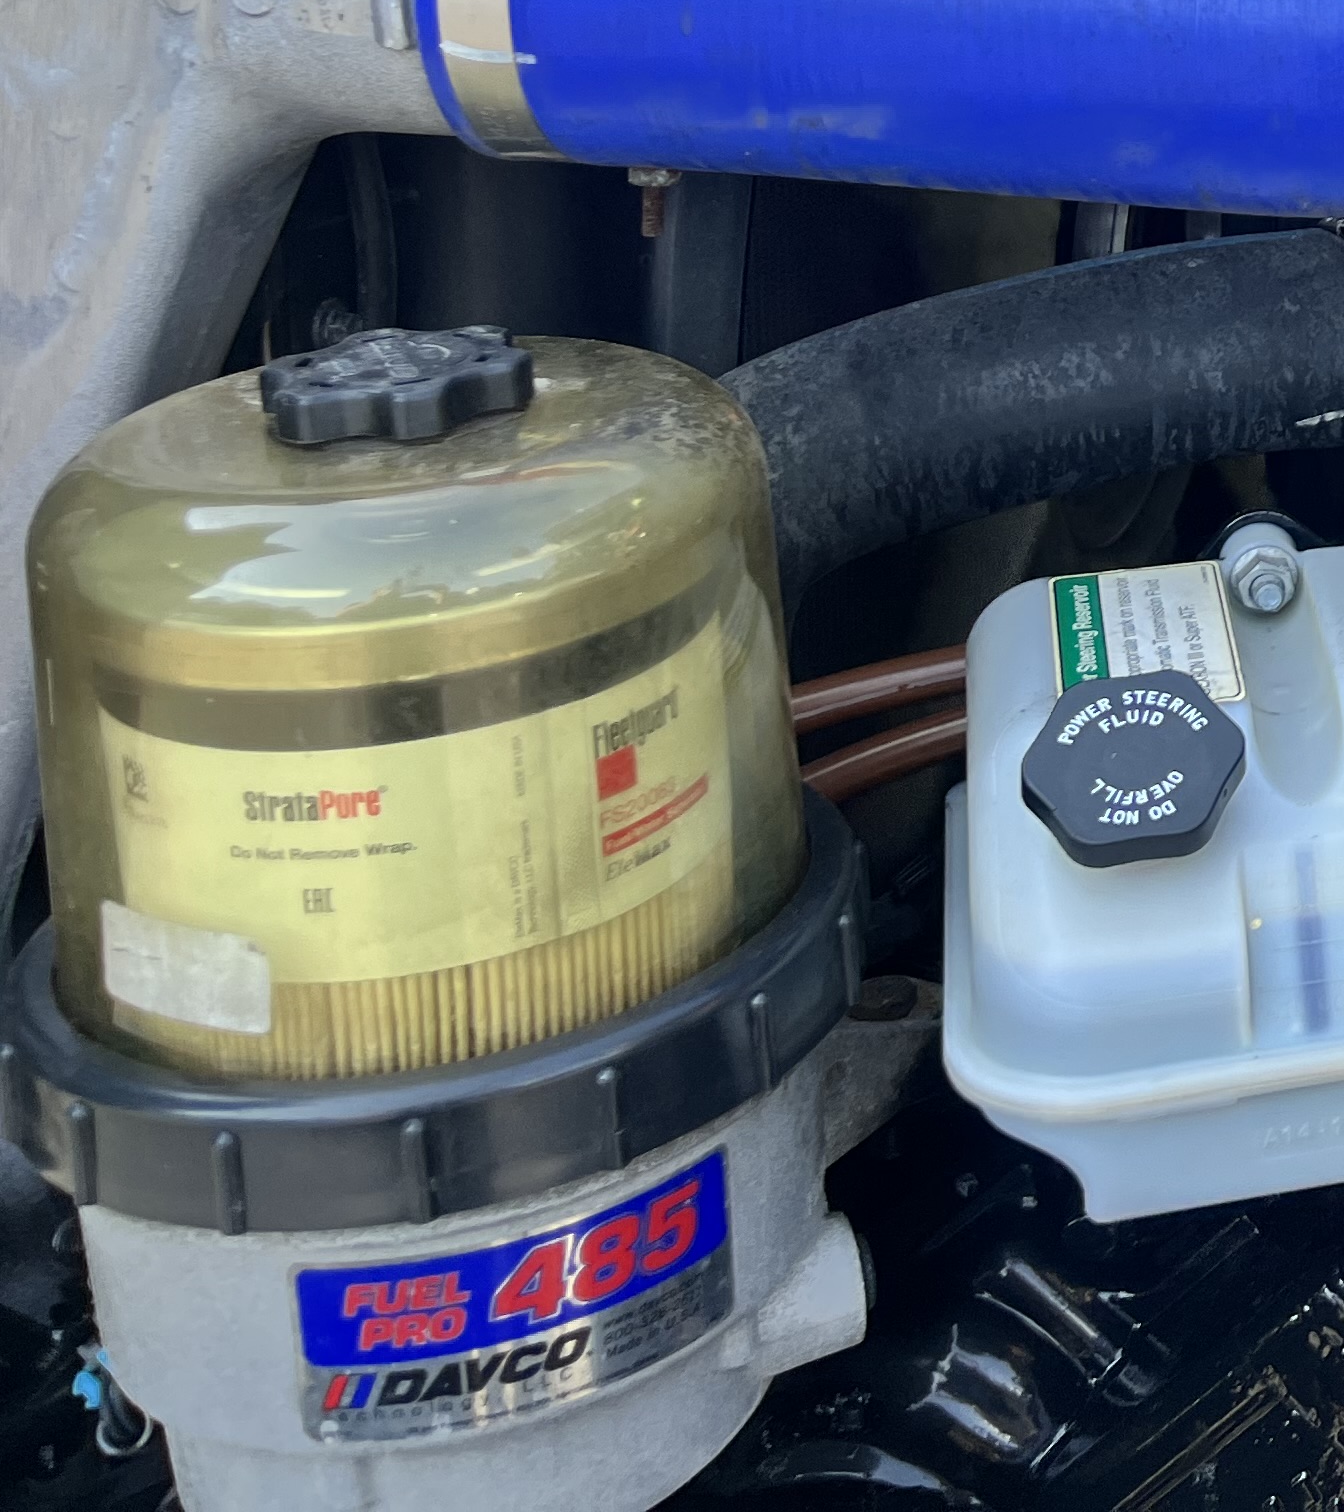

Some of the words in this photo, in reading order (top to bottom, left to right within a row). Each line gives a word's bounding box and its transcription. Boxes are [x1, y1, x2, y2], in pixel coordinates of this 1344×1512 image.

[1068, 584, 1093, 630] Reservoir
[1184, 618, 1204, 644] Super
[1076, 629, 1099, 674] Steering
[592, 685, 679, 760] Fleetguard
[1057, 698, 1112, 746] POWER
[1122, 690, 1209, 732] STEERING
[1098, 709, 1165, 734] FLUID
[242, 790, 382, 822] StrataPore
[1090, 769, 1185, 806] OVERFILL
[1098, 808, 1141, 826] NOT
[1149, 799, 1177, 821] DO
[230, 845, 252, 859] Do
[255, 847, 285, 860] Not
[289, 848, 360, 860] Remove
[364, 842, 418, 856] Wrap.
[342, 1271, 472, 1317] FUEL
[488, 1179, 701, 1324] 485
[357, 1306, 468, 1352] PRO
[605, 1334, 645, 1359] Made
[648, 1323, 662, 1340] in
[376, 1326, 593, 1407] DAVCO
